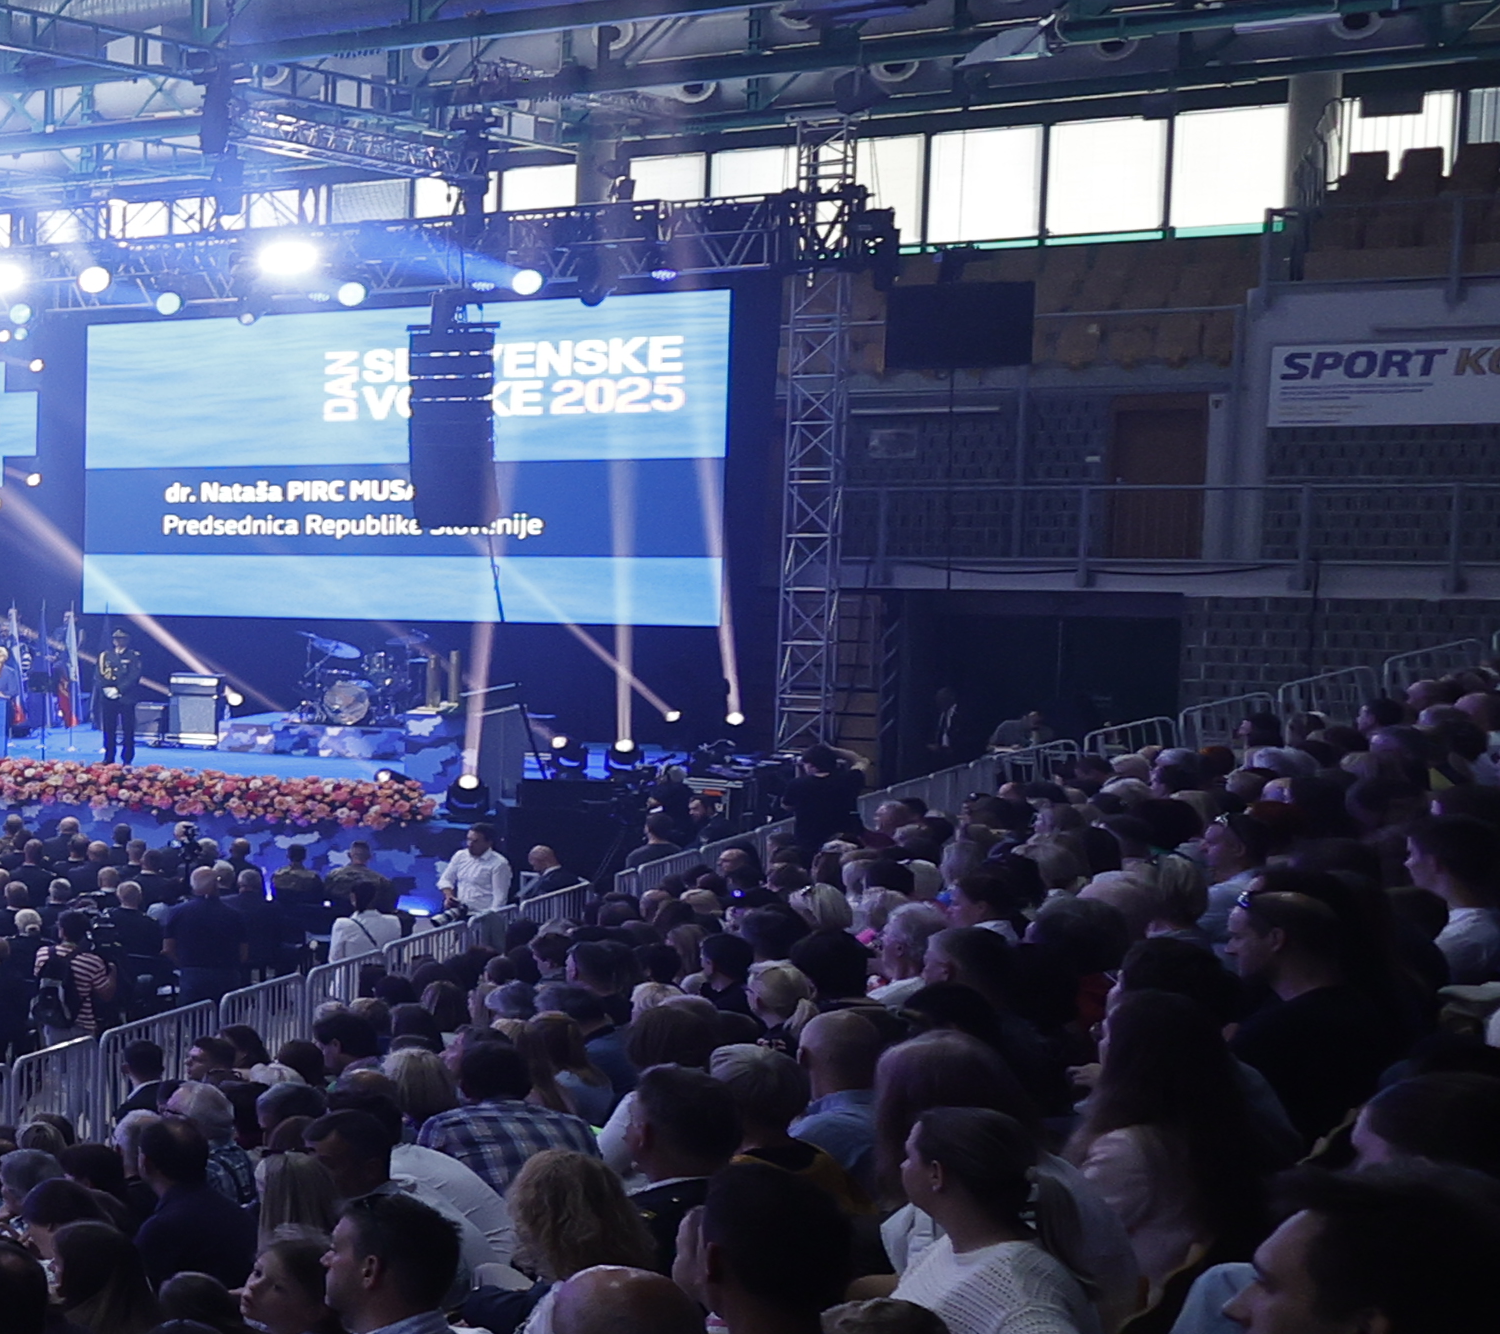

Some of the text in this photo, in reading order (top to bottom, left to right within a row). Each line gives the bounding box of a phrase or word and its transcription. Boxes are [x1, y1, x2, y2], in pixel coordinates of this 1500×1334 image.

[362, 335, 685, 383] SLENSKE
[1280, 348, 1449, 380] SPORT
[323, 350, 360, 422] DAN
[549, 375, 686, 415] 2025
[164, 482, 197, 503] dr.
[200, 480, 284, 503] Nataša
[287, 480, 346, 502] PIRC
[163, 514, 300, 536] Predsednica
[305, 513, 423, 540] Republike
